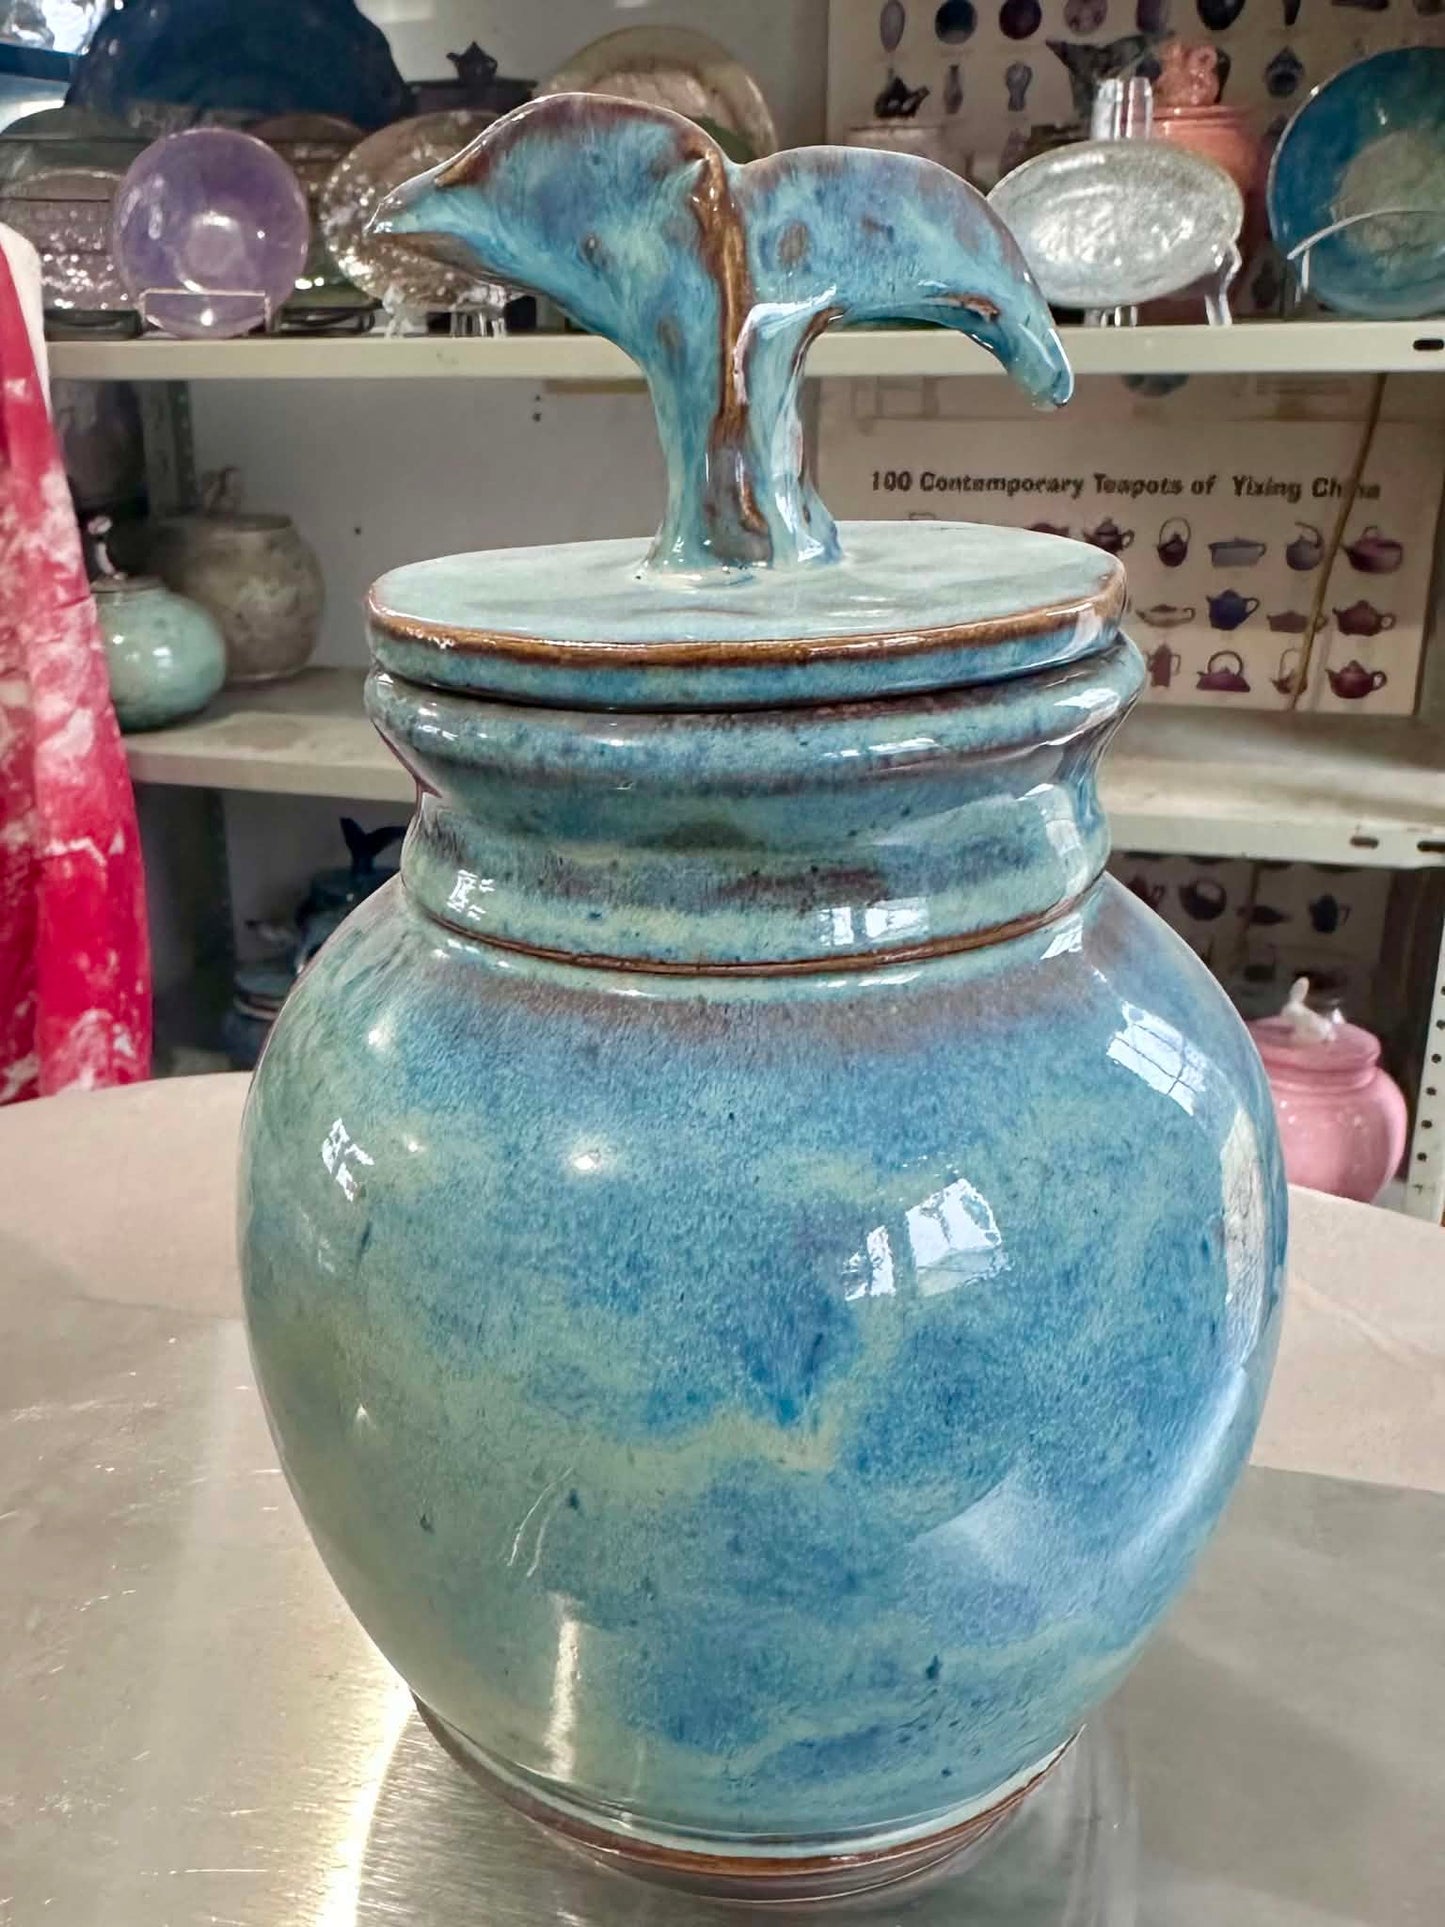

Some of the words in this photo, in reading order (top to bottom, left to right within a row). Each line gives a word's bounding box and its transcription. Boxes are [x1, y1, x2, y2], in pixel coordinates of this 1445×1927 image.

[872, 471, 912, 492] 100
[920, 472, 1083, 499] Contemporary
[1094, 473, 1183, 498] Teapots
[1190, 475, 1217, 496] of
[1232, 474, 1302, 503] Yixing
[1312, 477, 1381, 499] Chna
